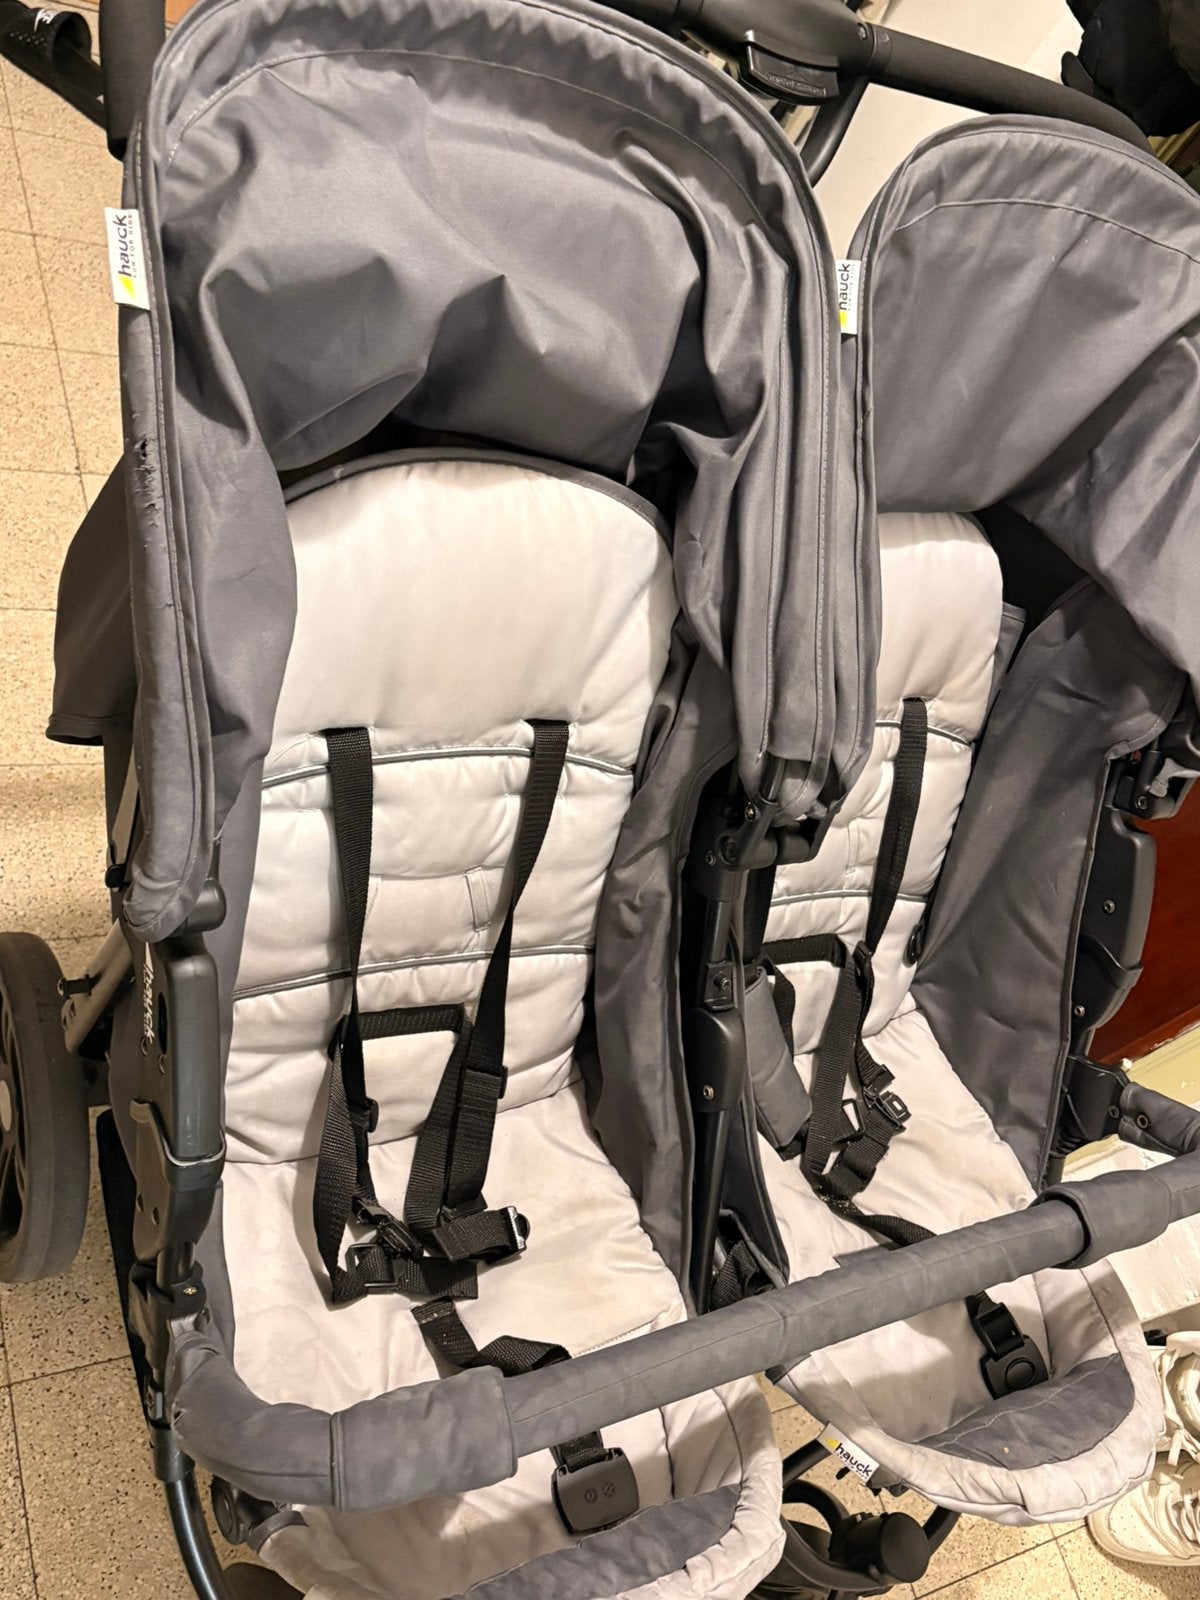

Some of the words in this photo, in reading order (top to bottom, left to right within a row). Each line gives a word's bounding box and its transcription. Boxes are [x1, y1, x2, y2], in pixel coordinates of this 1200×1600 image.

[112, 213, 132, 277] hauck
[144, 964, 155, 1044] hauck
[835, 1442, 872, 1477] hauck
